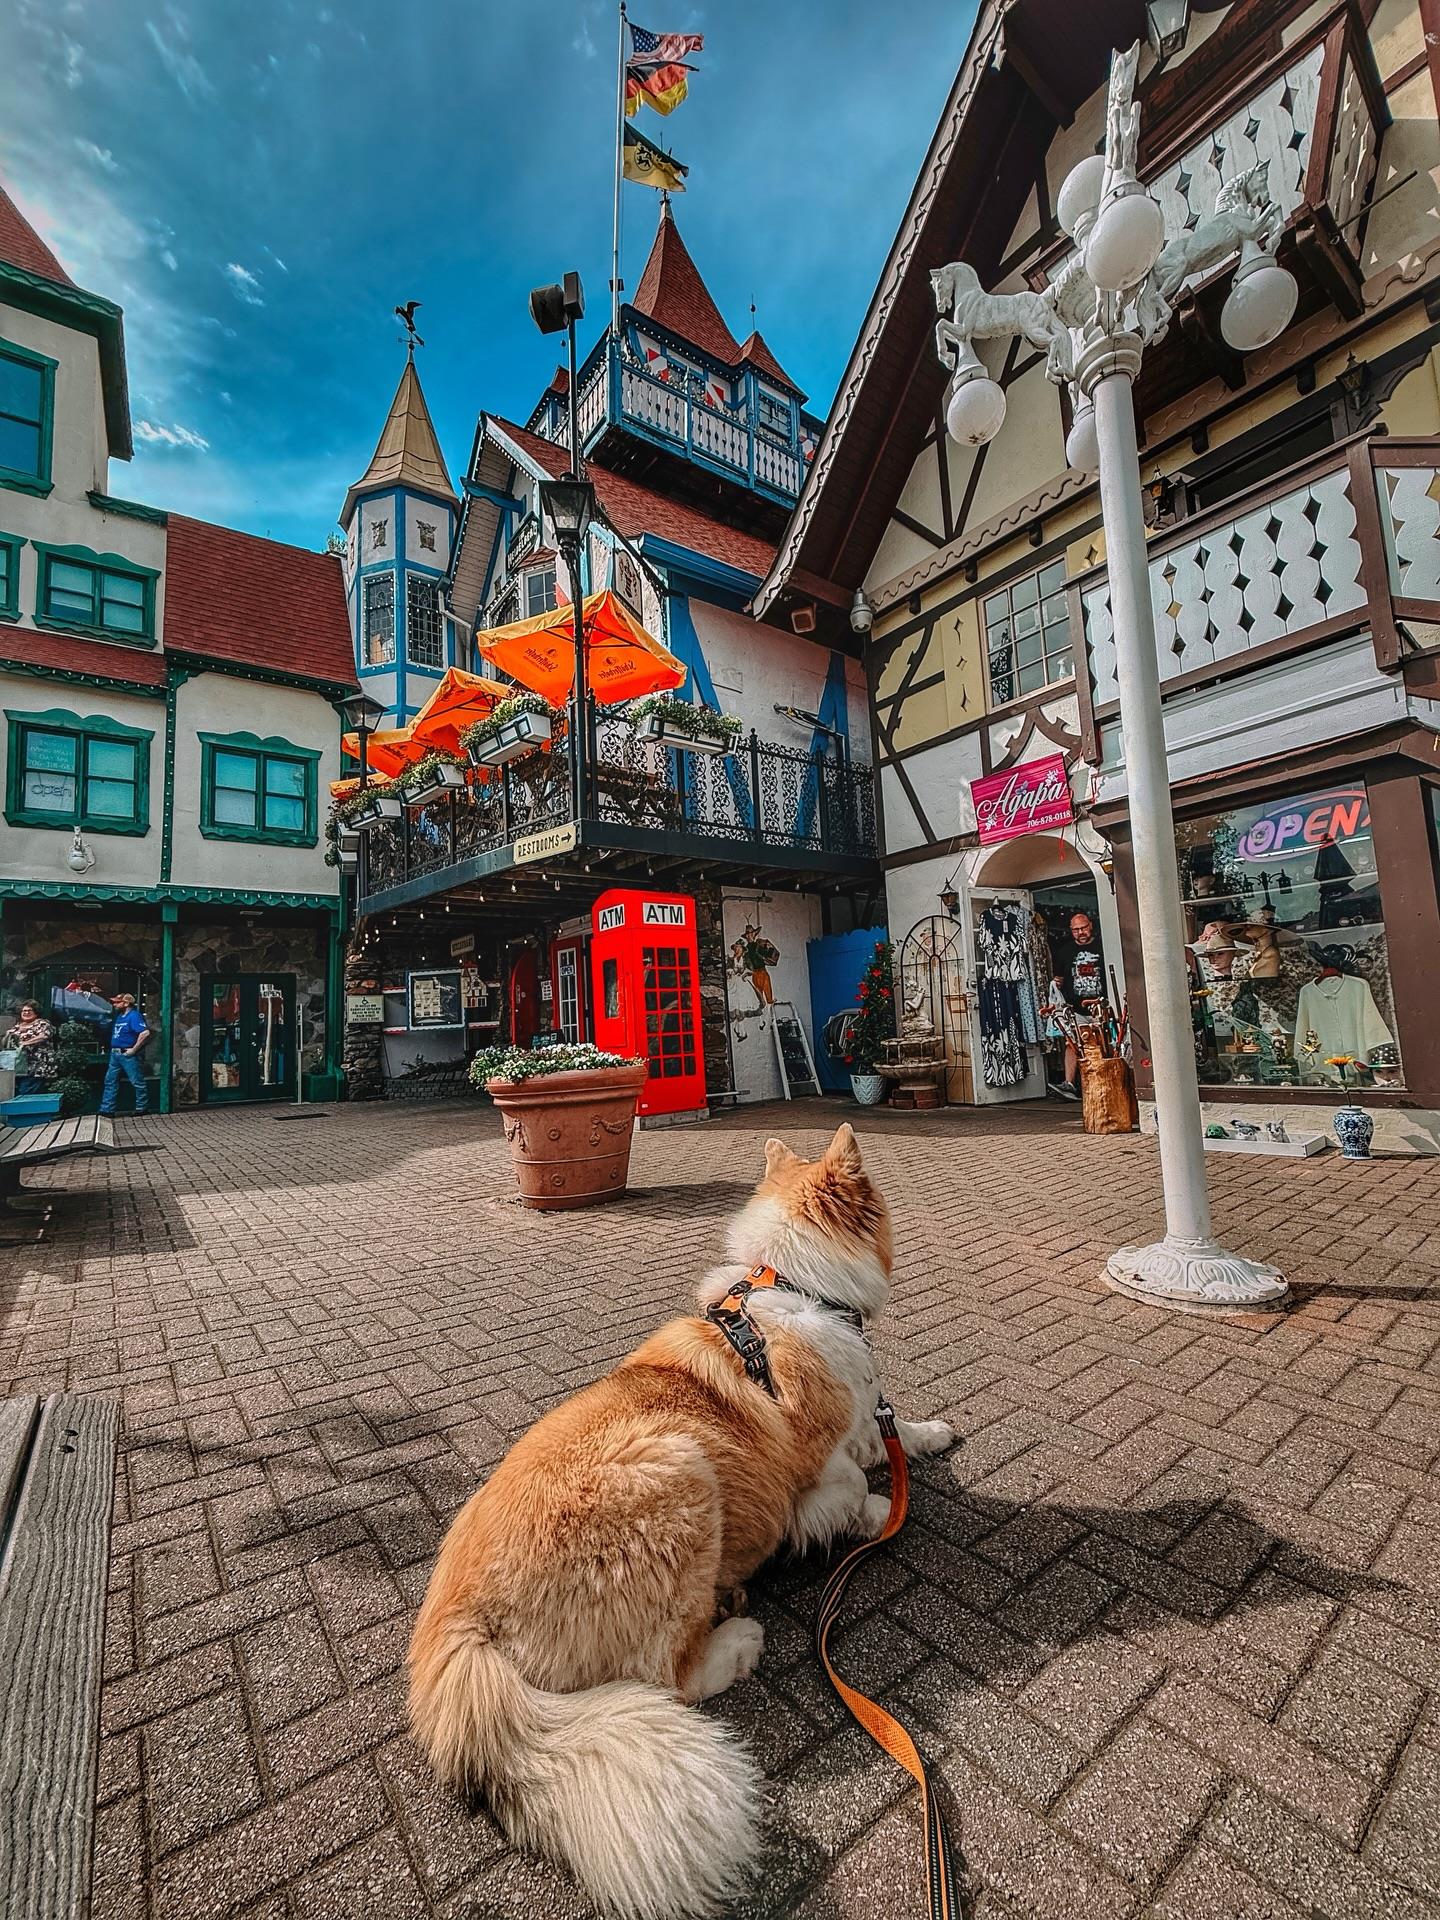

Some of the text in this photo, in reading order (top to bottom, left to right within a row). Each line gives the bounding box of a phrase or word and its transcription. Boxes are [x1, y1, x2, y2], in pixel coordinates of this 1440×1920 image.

[977, 773, 1067, 828] Agapa
[1027, 810, 1072, 828] 706-878-0118
[1246, 800, 1362, 853] OPEN
[517, 834, 560, 858] RESTROOMS
[601, 906, 625, 930] ATM
[646, 904, 684, 924] ATM
